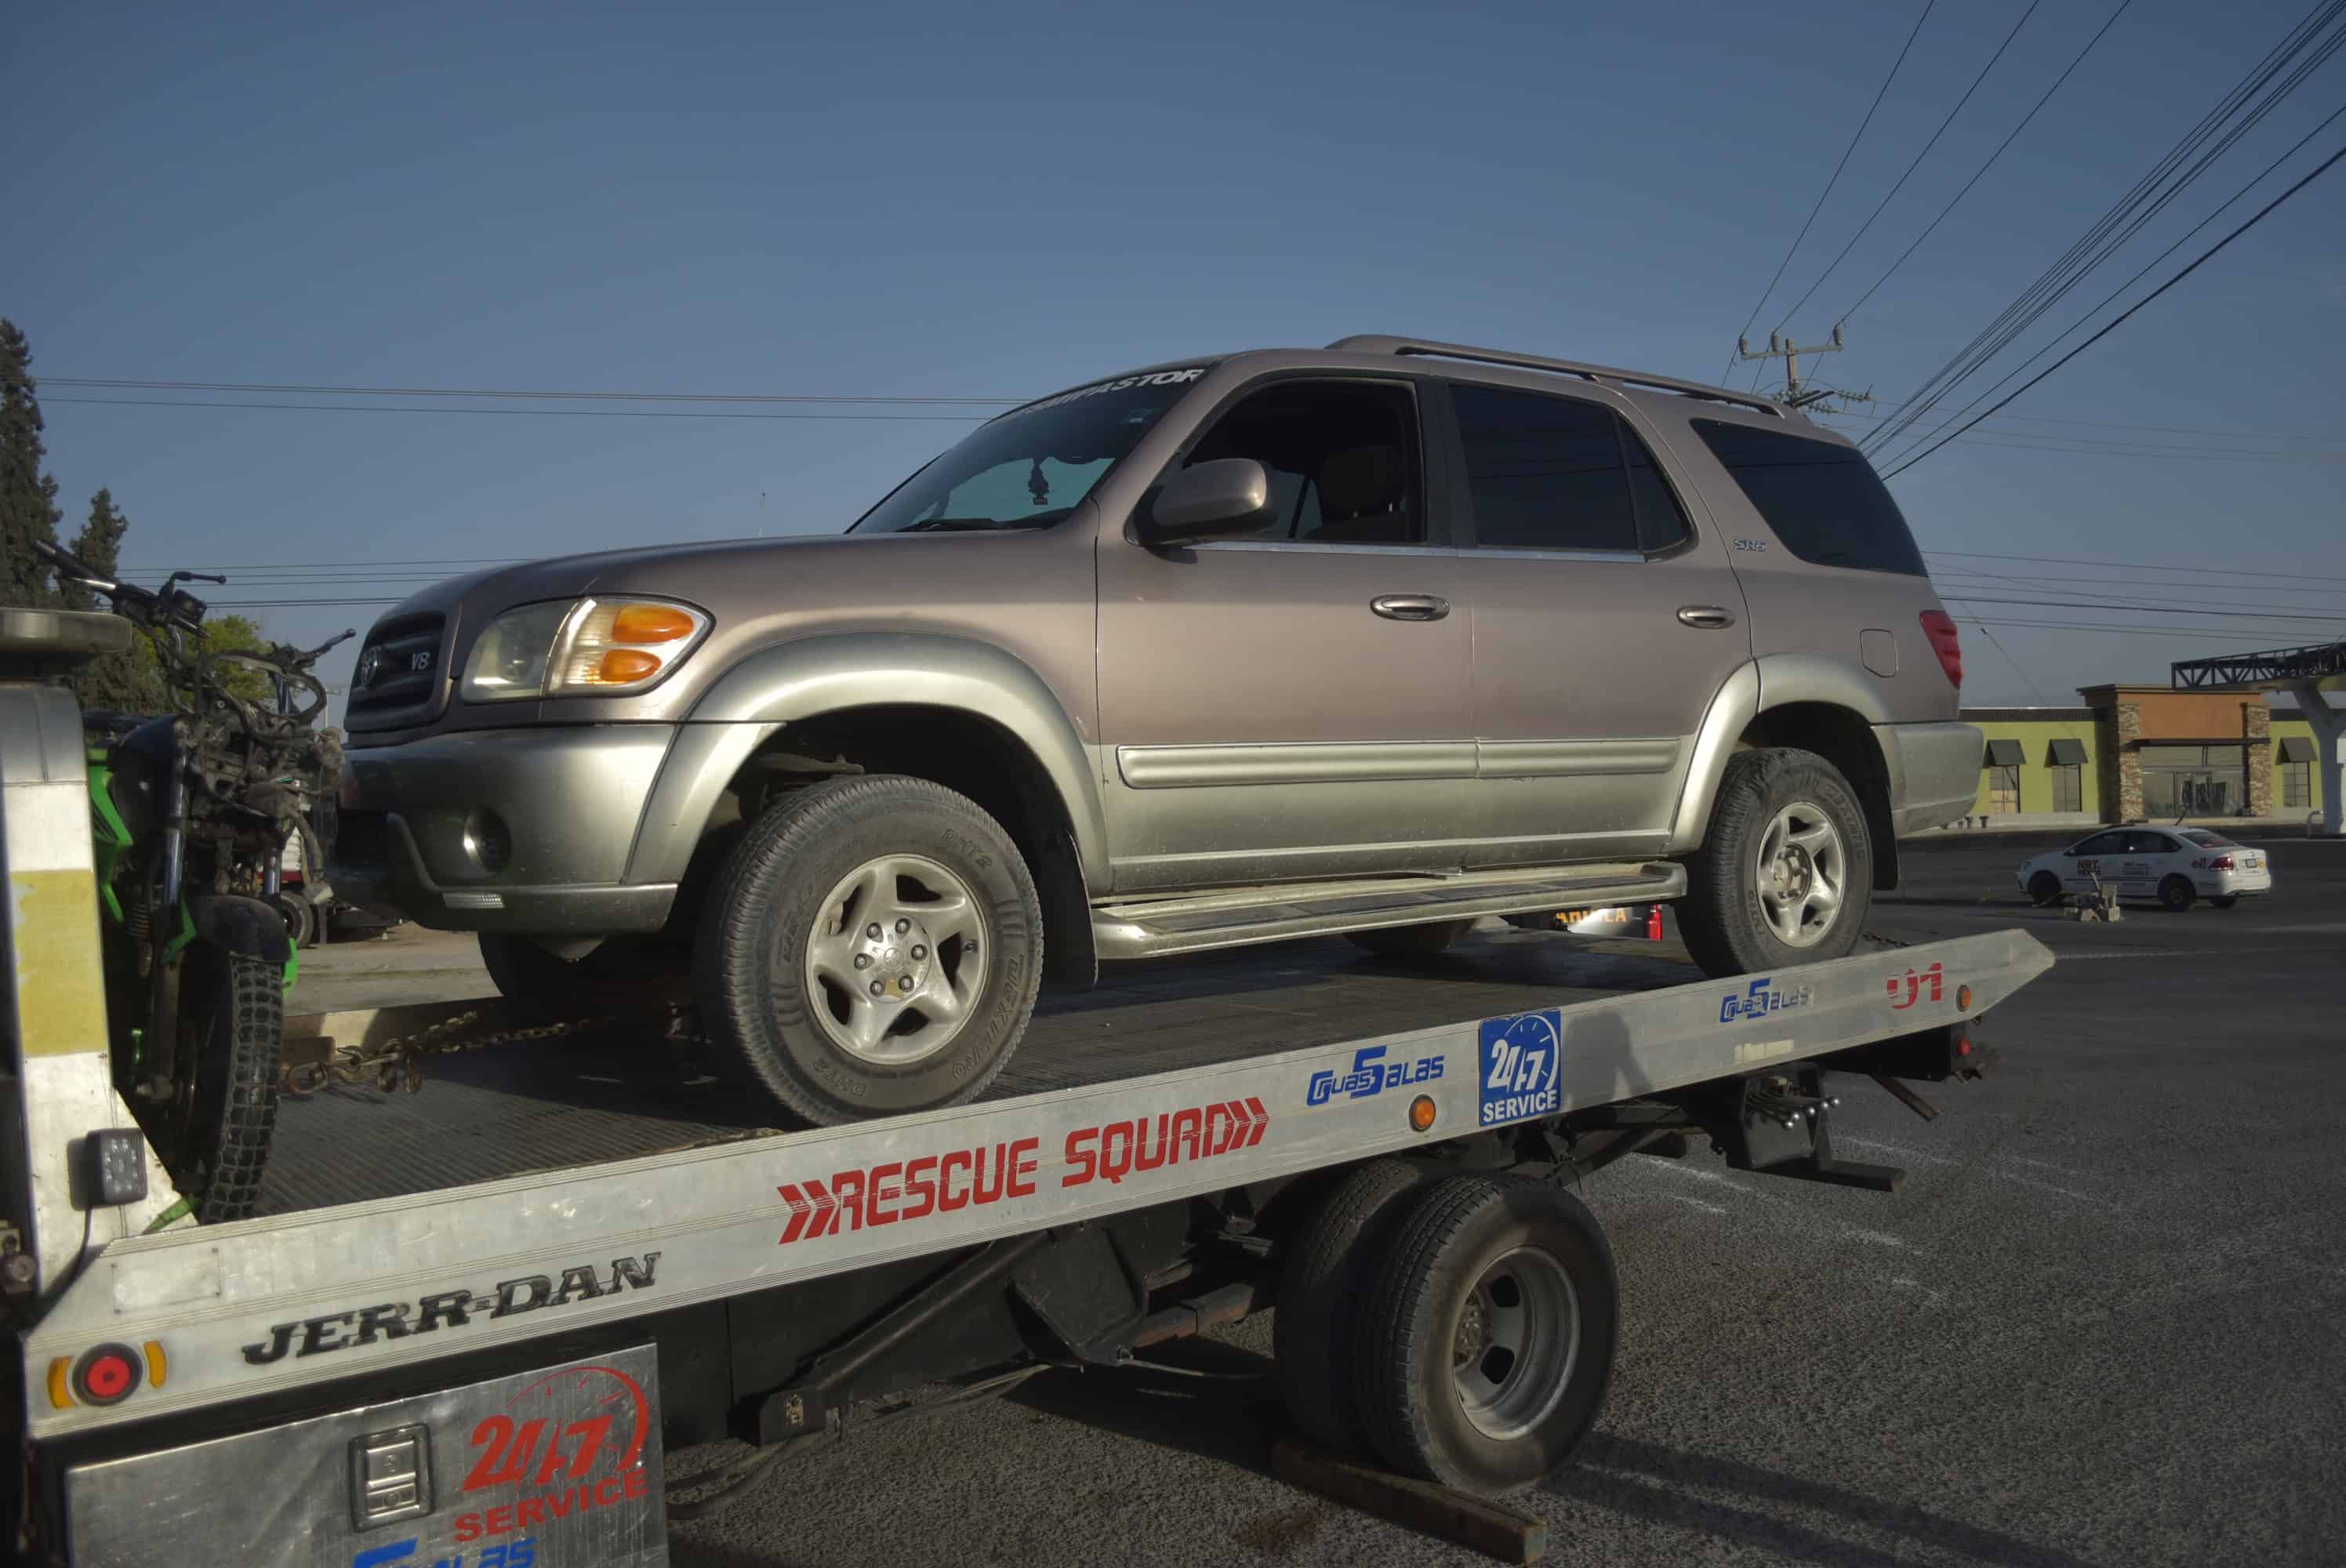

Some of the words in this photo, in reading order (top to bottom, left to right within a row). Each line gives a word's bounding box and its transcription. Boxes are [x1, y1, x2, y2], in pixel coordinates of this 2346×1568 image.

[411, 652, 430, 671] V8
[1488, 1038, 1545, 1092] 24/7
[1483, 1088, 1558, 1123] SERVICE
[828, 1137, 1040, 1236] RESCUE
[1061, 1102, 1235, 1189] SQUAD
[241, 1253, 662, 1366] JERR-DAN
[461, 1414, 615, 1494] 24/7
[454, 1467, 648, 1543] SERVICE
